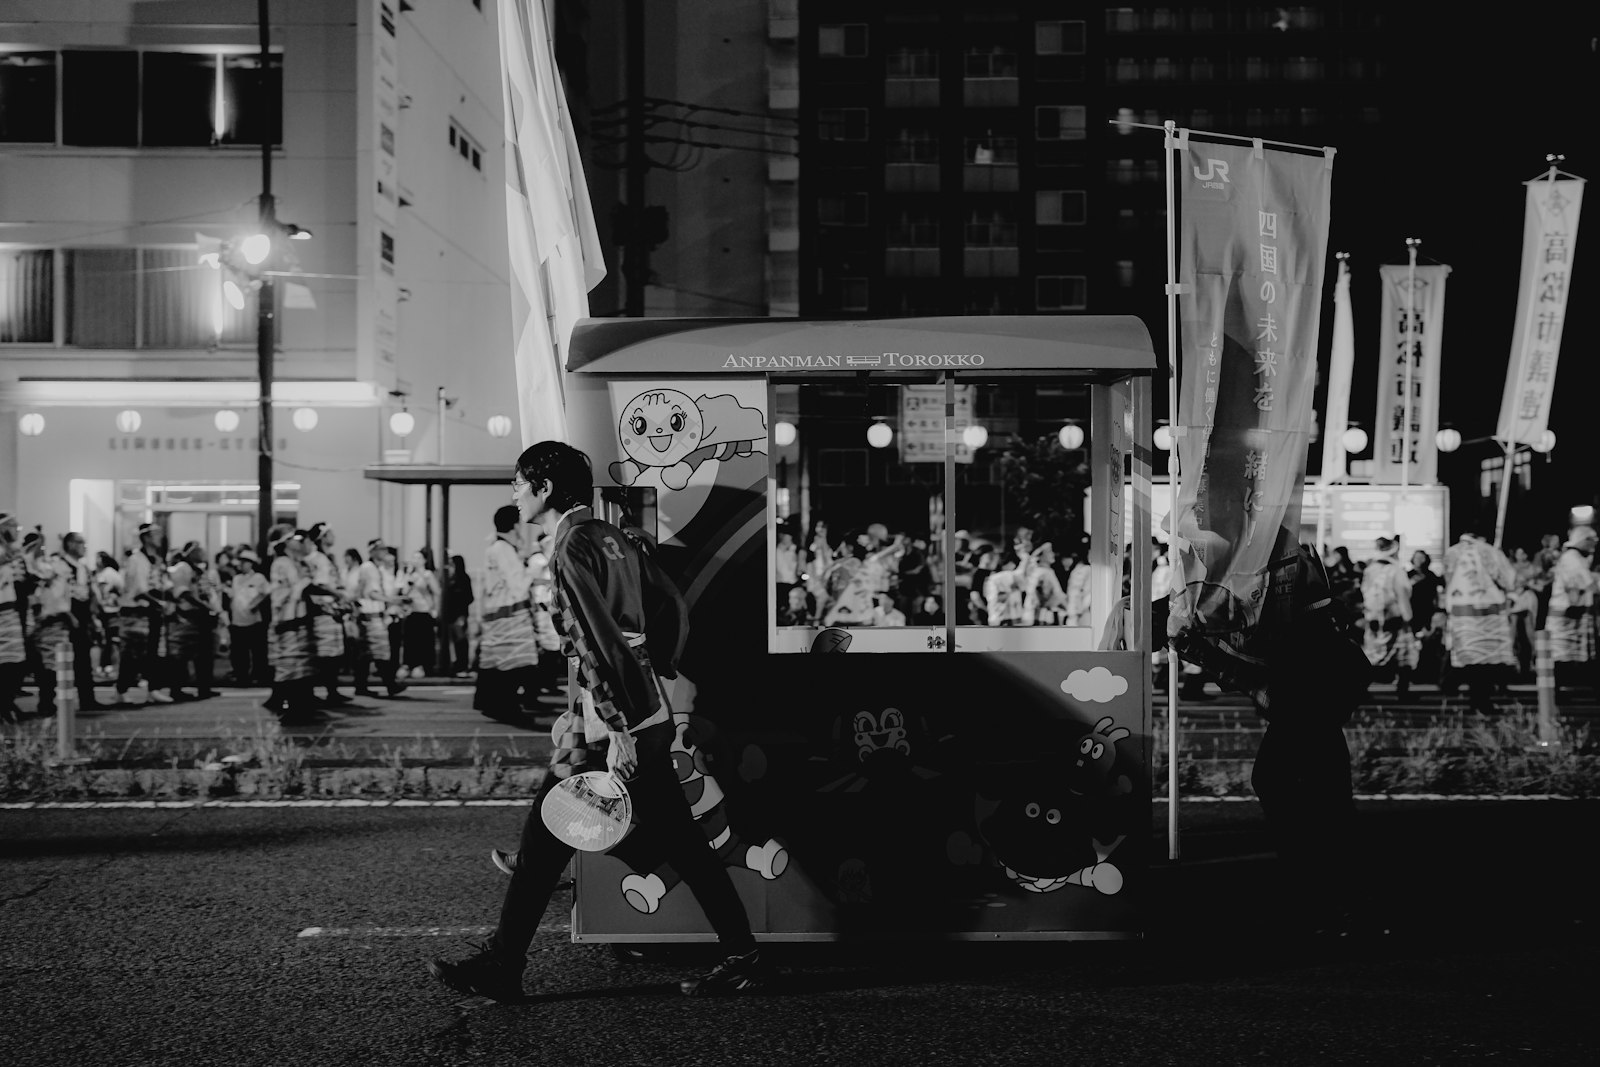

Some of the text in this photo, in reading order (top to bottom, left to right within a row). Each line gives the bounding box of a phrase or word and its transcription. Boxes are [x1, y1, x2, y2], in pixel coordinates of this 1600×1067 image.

[1193, 158, 1230, 183] JR
[721, 352, 985, 368] ANPANMAN TOROKKO
